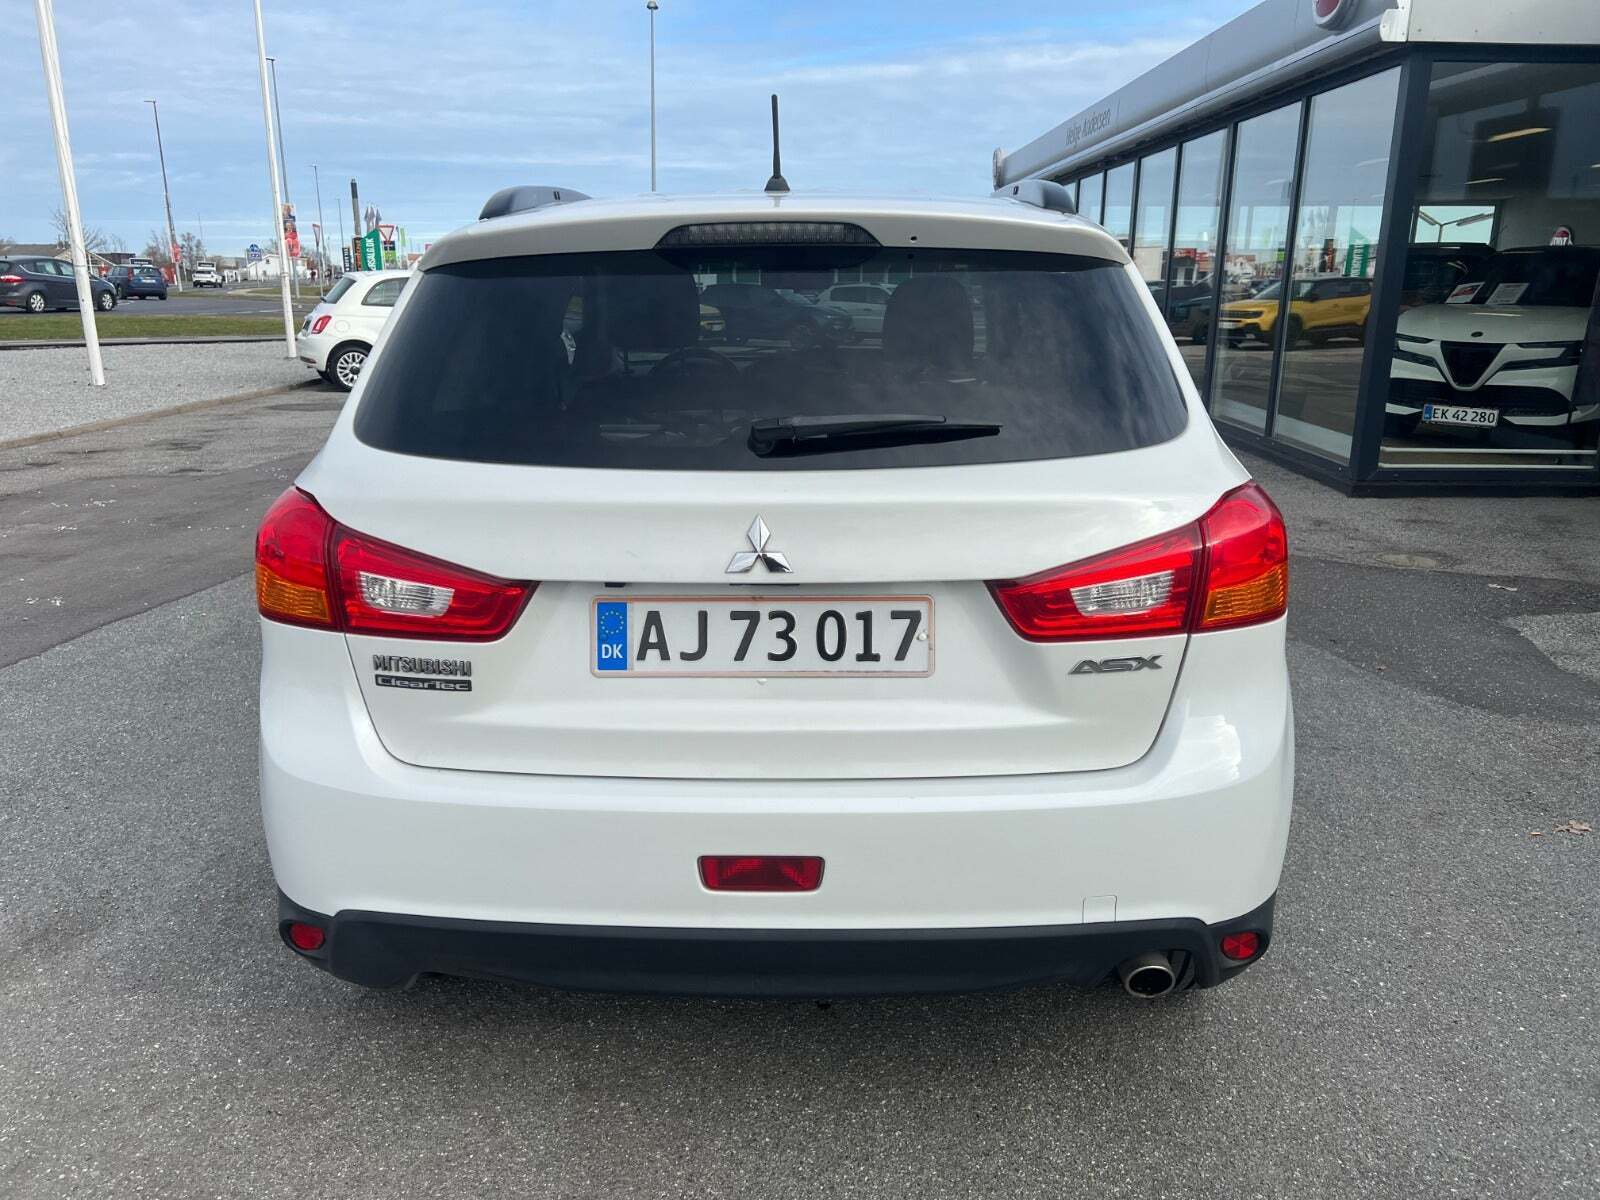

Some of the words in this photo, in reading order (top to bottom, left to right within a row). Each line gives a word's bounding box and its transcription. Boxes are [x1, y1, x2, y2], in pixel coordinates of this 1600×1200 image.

[1432, 408, 1450, 420] EK
[1452, 409, 1468, 422] 42
[1471, 411, 1496, 424] 280
[636, 610, 709, 662] AJ
[729, 610, 799, 662] 73
[815, 610, 923, 662] 017
[601, 644, 624, 659] DK
[372, 654, 472, 677] MITSUBISHI
[1068, 654, 1163, 675] ASX
